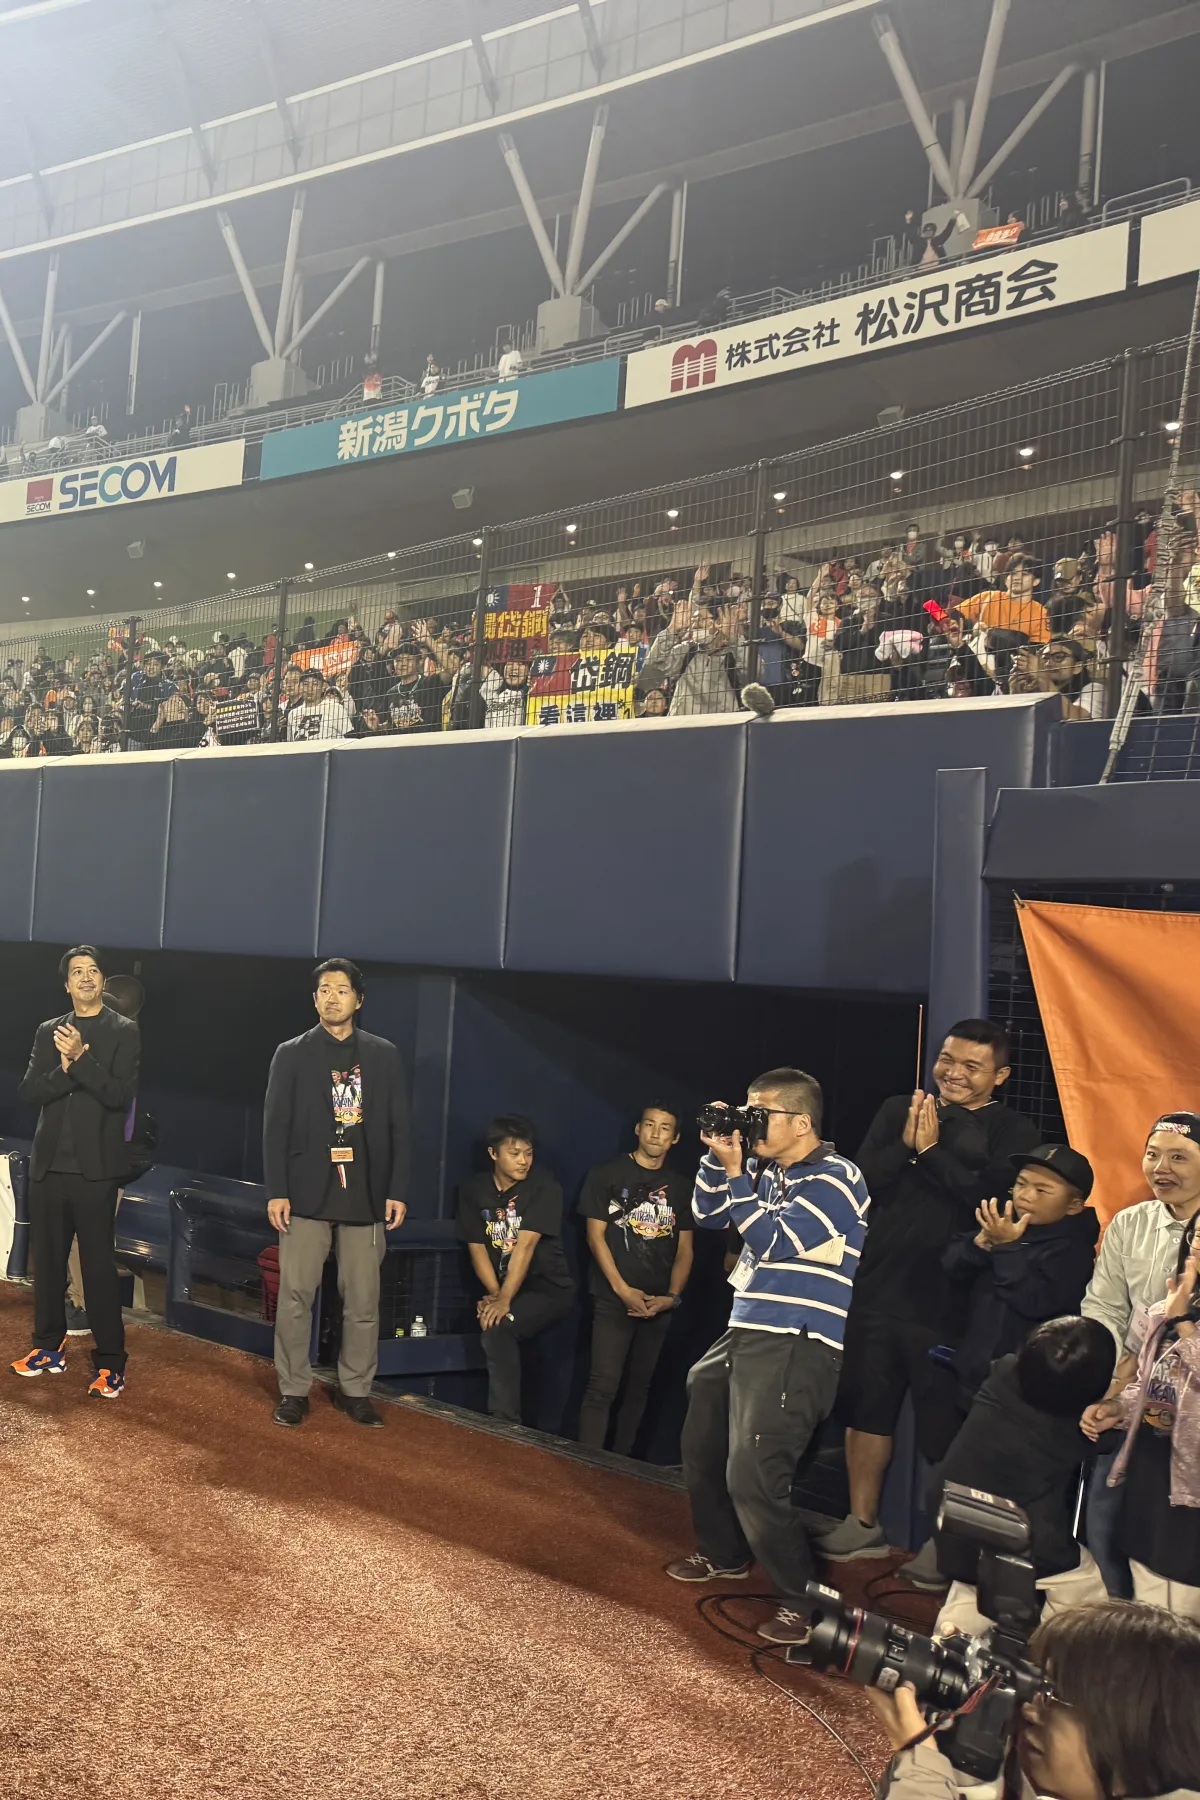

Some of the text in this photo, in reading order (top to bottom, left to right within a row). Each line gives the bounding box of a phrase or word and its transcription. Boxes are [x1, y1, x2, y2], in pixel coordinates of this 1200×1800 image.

[725, 258, 1059, 372] 株式会社 松沢商会
[336, 389, 519, 460] 新潟クボタ
[26, 501, 51, 513] SECOM
[58, 455, 178, 511] SECOM
[530, 584, 543, 609] 1
